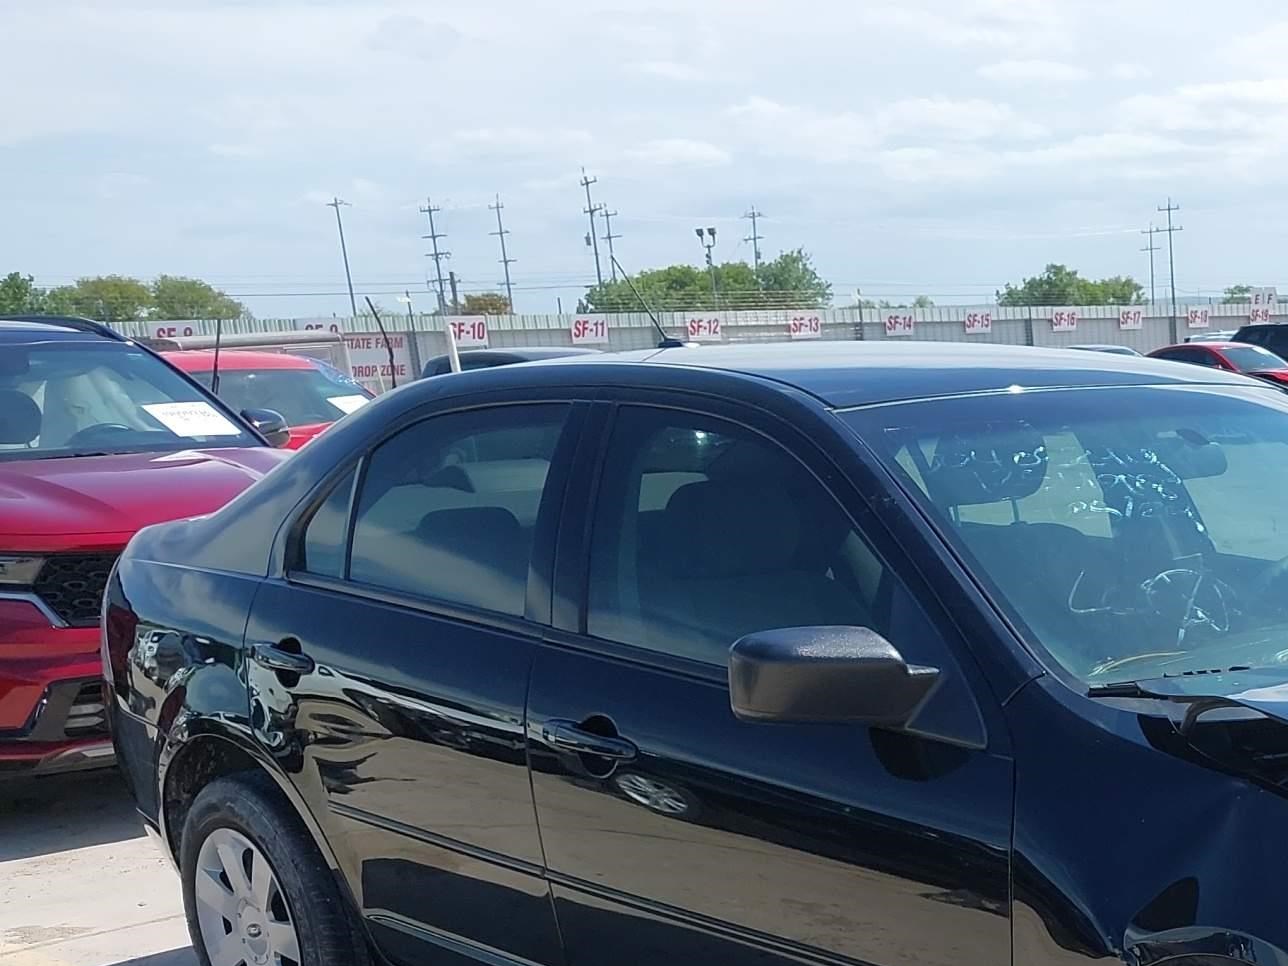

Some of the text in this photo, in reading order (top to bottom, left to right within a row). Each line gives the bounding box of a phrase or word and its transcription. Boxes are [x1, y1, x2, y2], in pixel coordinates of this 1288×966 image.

[1254, 293, 1274, 305] E F
[790, 316, 820, 334] SF-13
[886, 315, 913, 331] SF-14
[966, 312, 991, 329] SF-15
[1052, 312, 1076, 328] SF-16
[1120, 311, 1142, 326] SF-17
[450, 321, 486, 341] SF-10
[573, 319, 606, 338] SF-11
[689, 318, 720, 336] SF-12
[346, 336, 403, 350] TATE FARM
[351, 364, 406, 378] DROP ZONE
